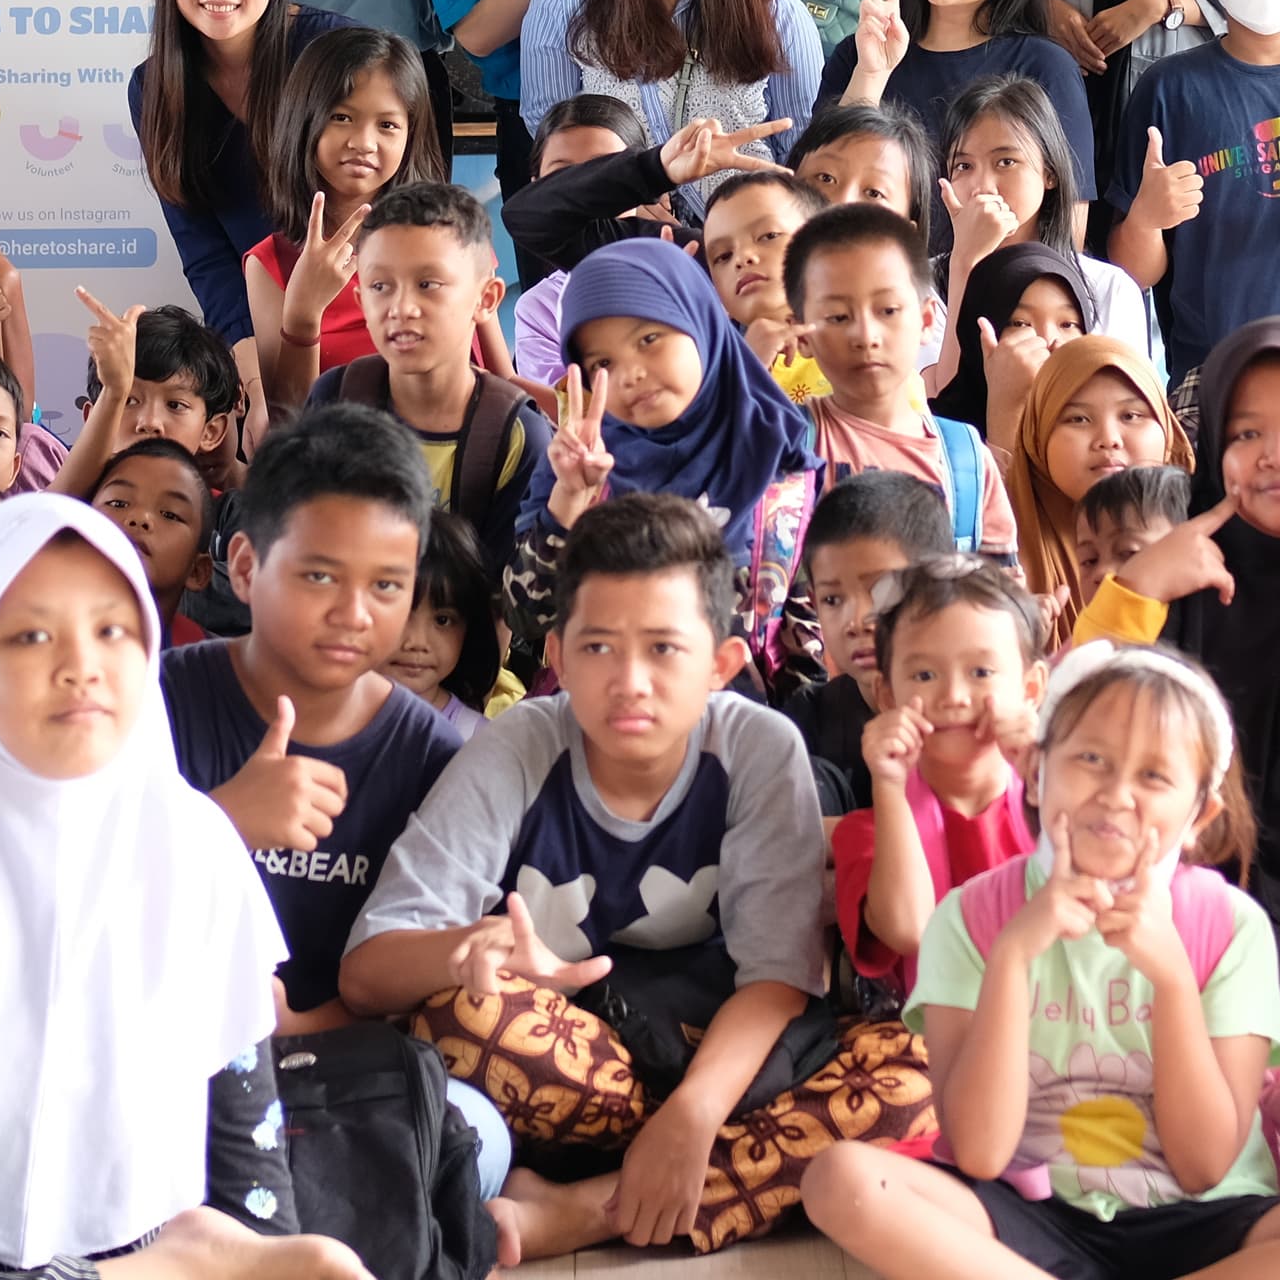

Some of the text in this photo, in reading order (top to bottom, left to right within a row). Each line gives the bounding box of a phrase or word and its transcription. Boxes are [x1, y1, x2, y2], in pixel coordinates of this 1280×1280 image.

[9, 6, 61, 35] TO
[77, 67, 124, 83] With
[24, 160, 76, 178] Volunteer
[18, 210, 34, 222] us
[38, 210, 56, 222] on
[60, 207, 131, 223] Instagram
